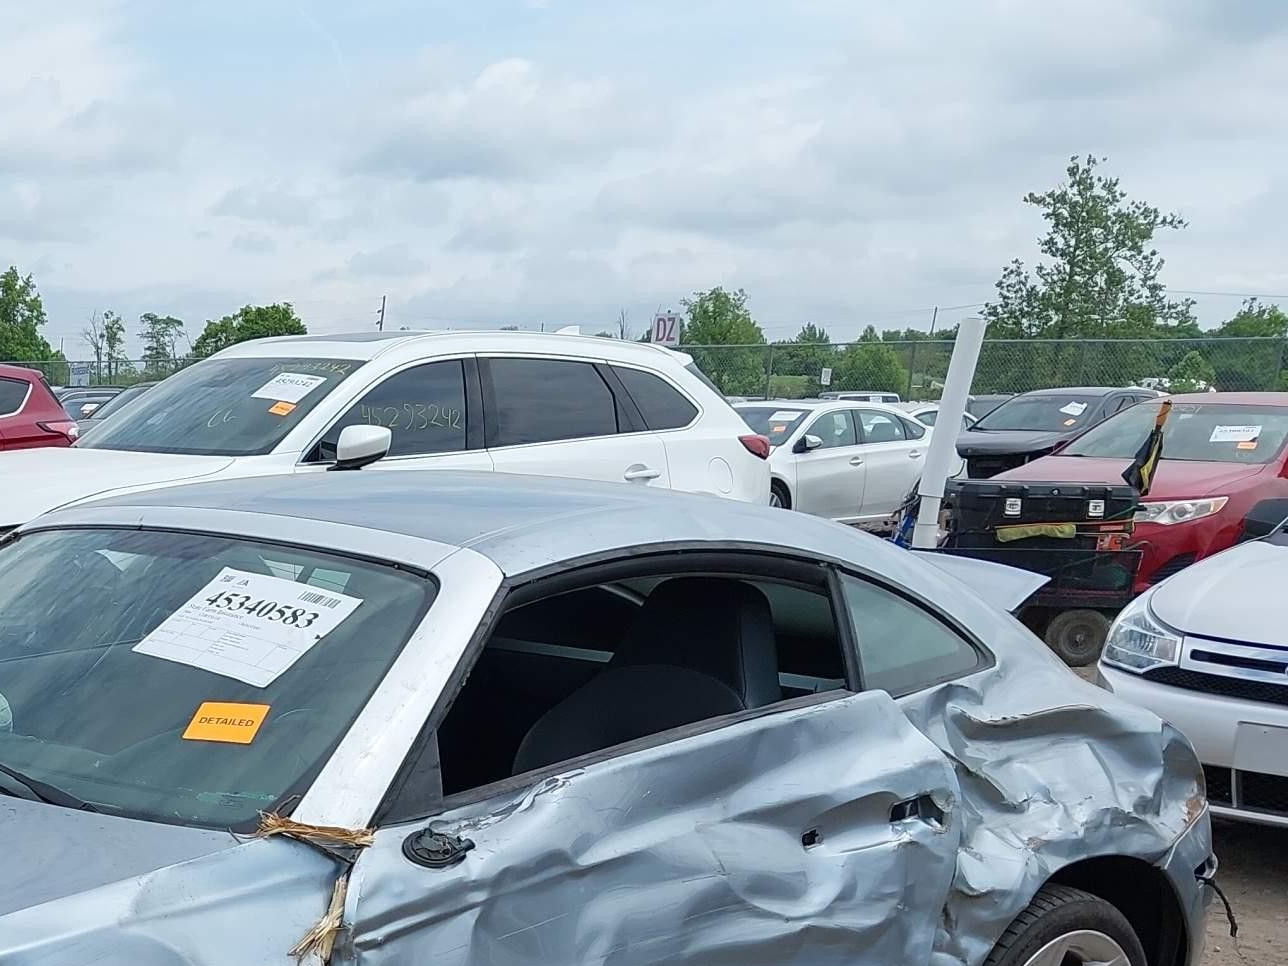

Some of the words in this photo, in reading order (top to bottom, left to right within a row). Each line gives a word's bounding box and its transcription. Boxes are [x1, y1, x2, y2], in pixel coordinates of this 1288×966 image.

[655, 317, 676, 342] DZ
[361, 403, 462, 430] 45293242
[205, 591, 320, 629] 45340583
[198, 716, 255, 728] DETAILED
